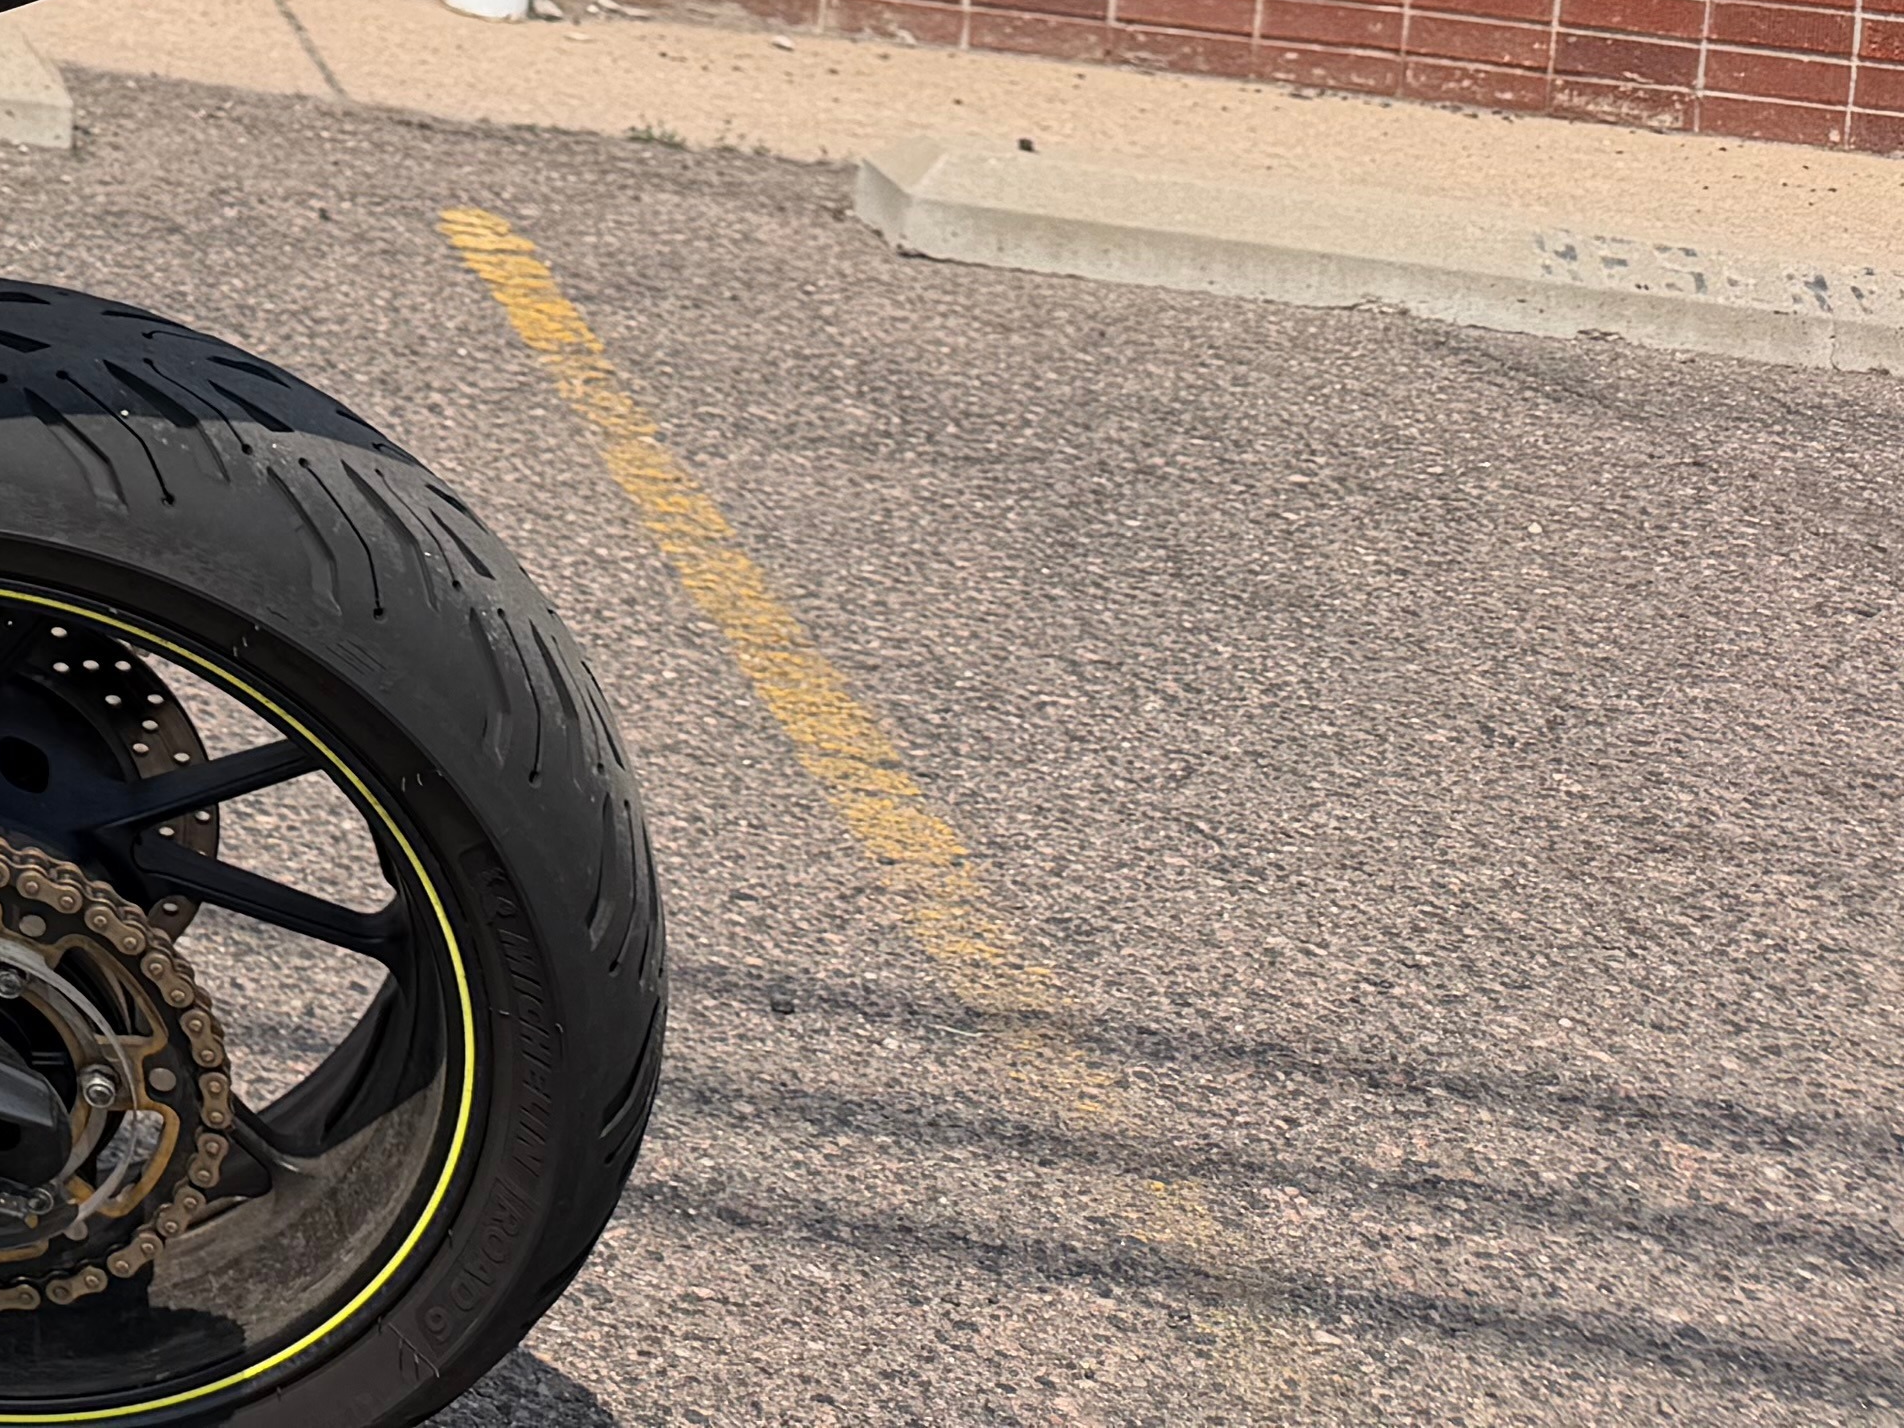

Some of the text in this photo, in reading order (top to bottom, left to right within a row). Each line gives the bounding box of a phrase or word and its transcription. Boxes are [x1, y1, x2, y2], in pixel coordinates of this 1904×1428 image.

[428, 929, 552, 1345] MICHELIN ROAD 6
